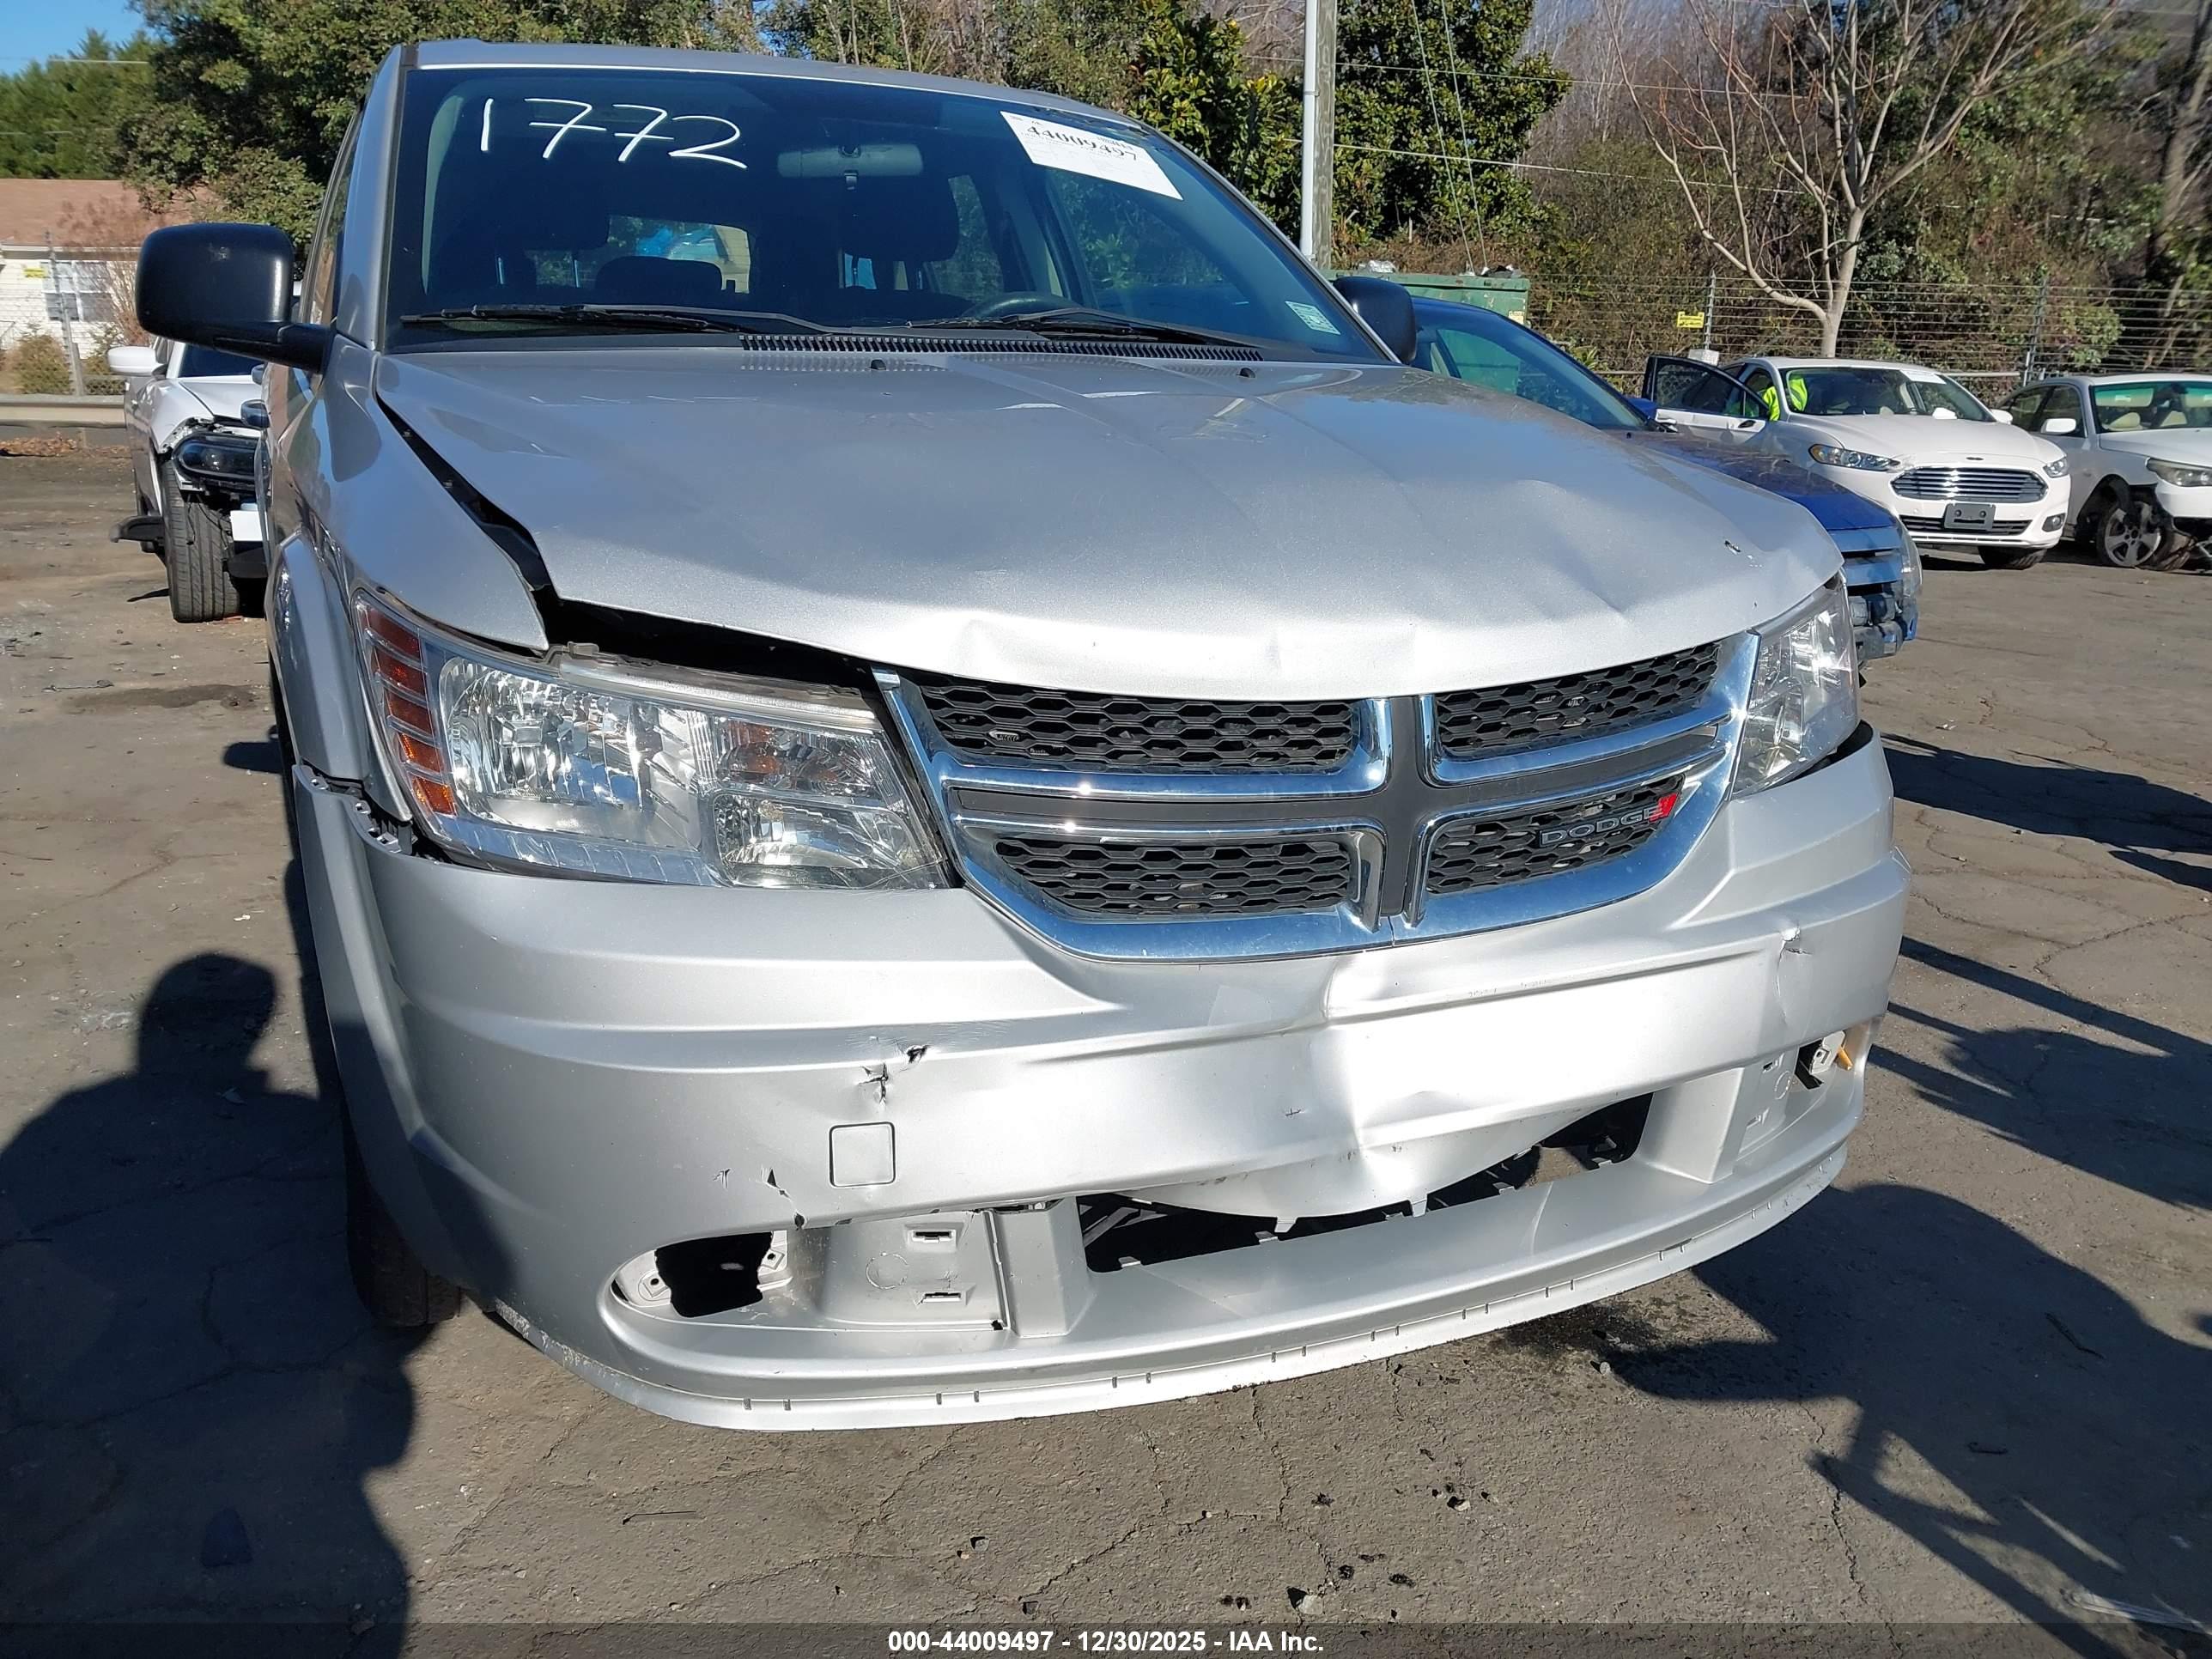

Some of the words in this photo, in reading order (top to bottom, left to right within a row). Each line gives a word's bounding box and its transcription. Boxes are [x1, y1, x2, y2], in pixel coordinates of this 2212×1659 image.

[479, 97, 748, 169] 1772
[1026, 125, 1137, 161] 44009497
[1540, 805, 1666, 846] DODGE
